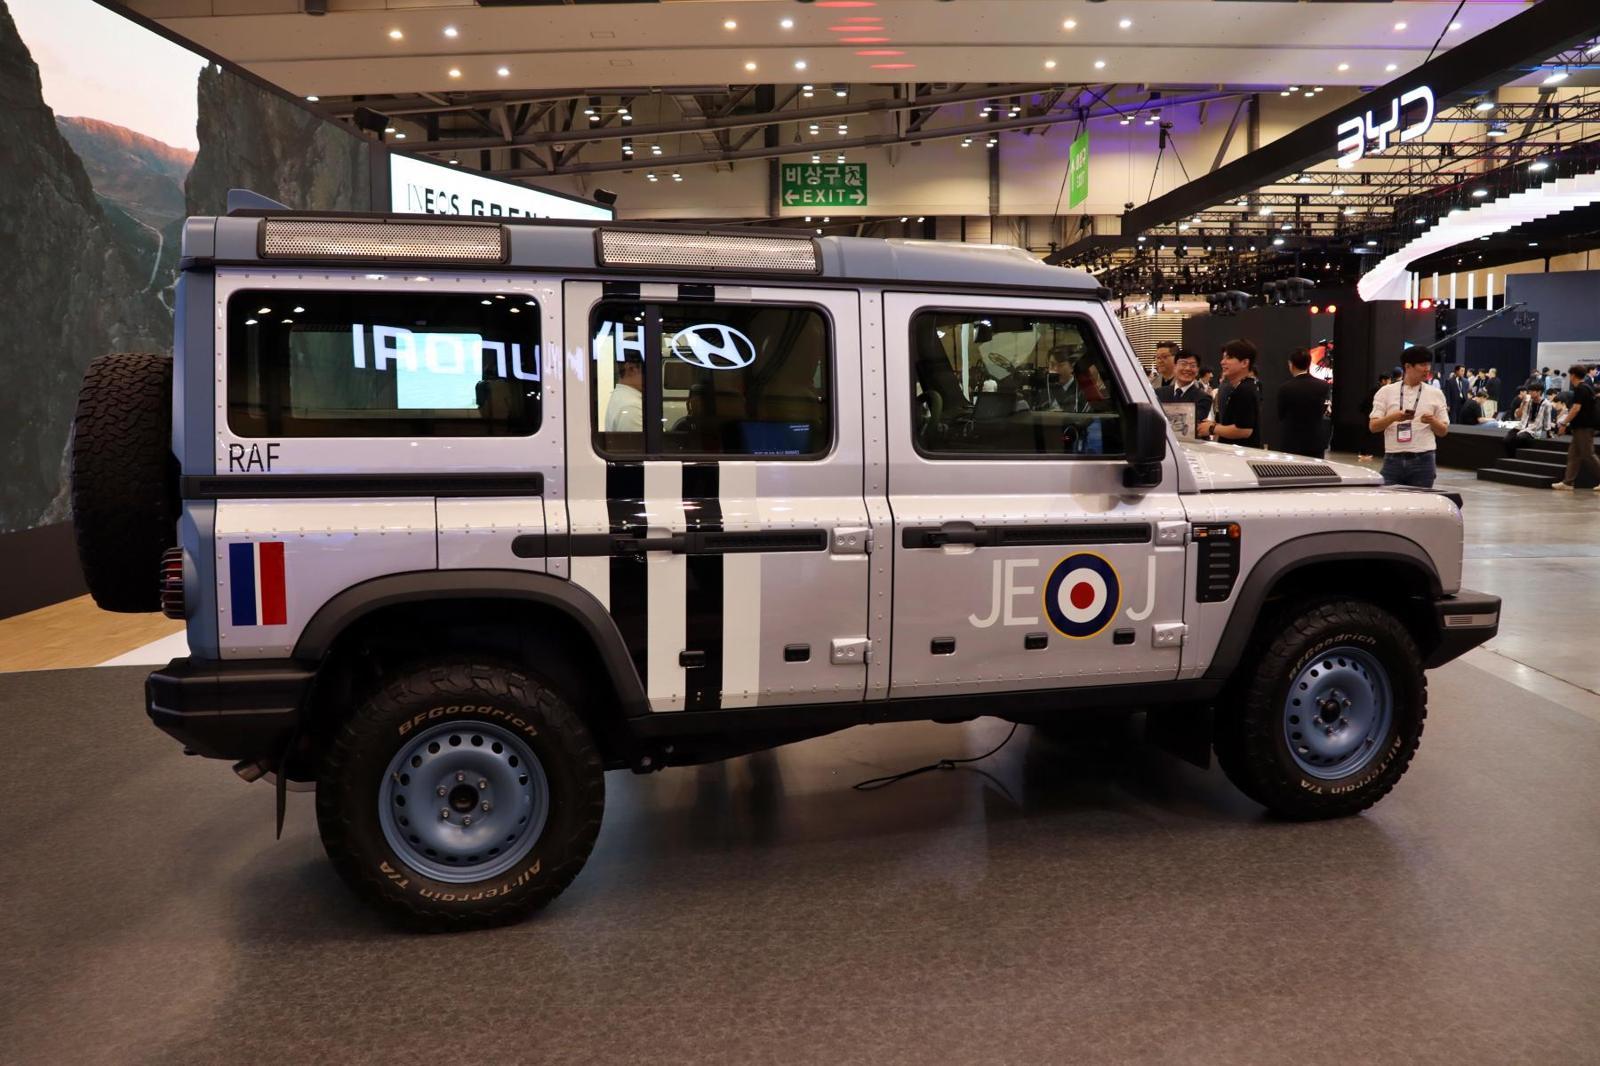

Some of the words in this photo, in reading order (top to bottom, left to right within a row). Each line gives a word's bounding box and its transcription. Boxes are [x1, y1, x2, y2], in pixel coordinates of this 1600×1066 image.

[1337, 85, 1434, 169] BYD
[786, 166, 841, 186] 비상구
[803, 189, 846, 203] EXIT
[229, 443, 281, 473] RAF
[398, 704, 539, 737] BFGoodrich
[379, 860, 410, 889] T/A
[418, 858, 543, 902] All-Terrain
